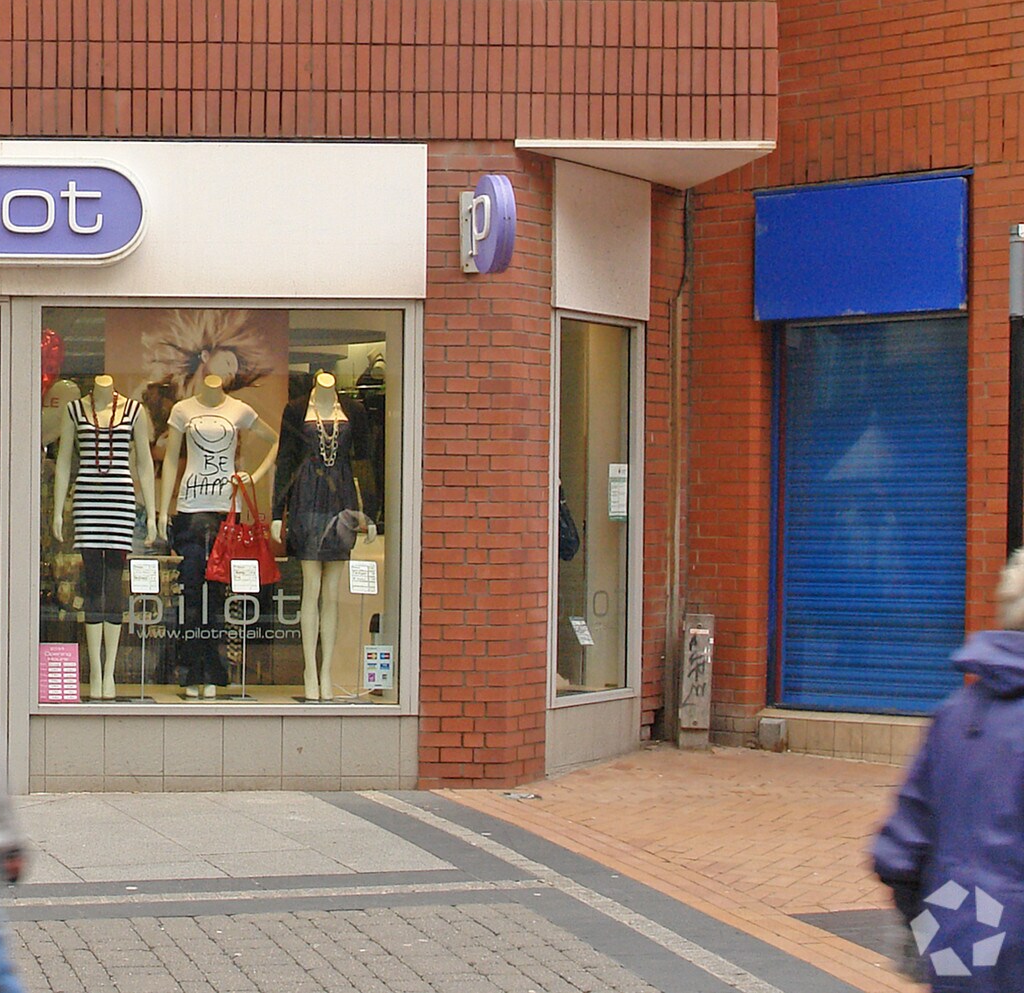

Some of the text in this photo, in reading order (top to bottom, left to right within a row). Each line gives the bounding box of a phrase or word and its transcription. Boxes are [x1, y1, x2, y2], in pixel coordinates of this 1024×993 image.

[199, 454, 229, 476] BE
[129, 582, 301, 634] pilot
[136, 627, 301, 642] www.pilotretail.com
